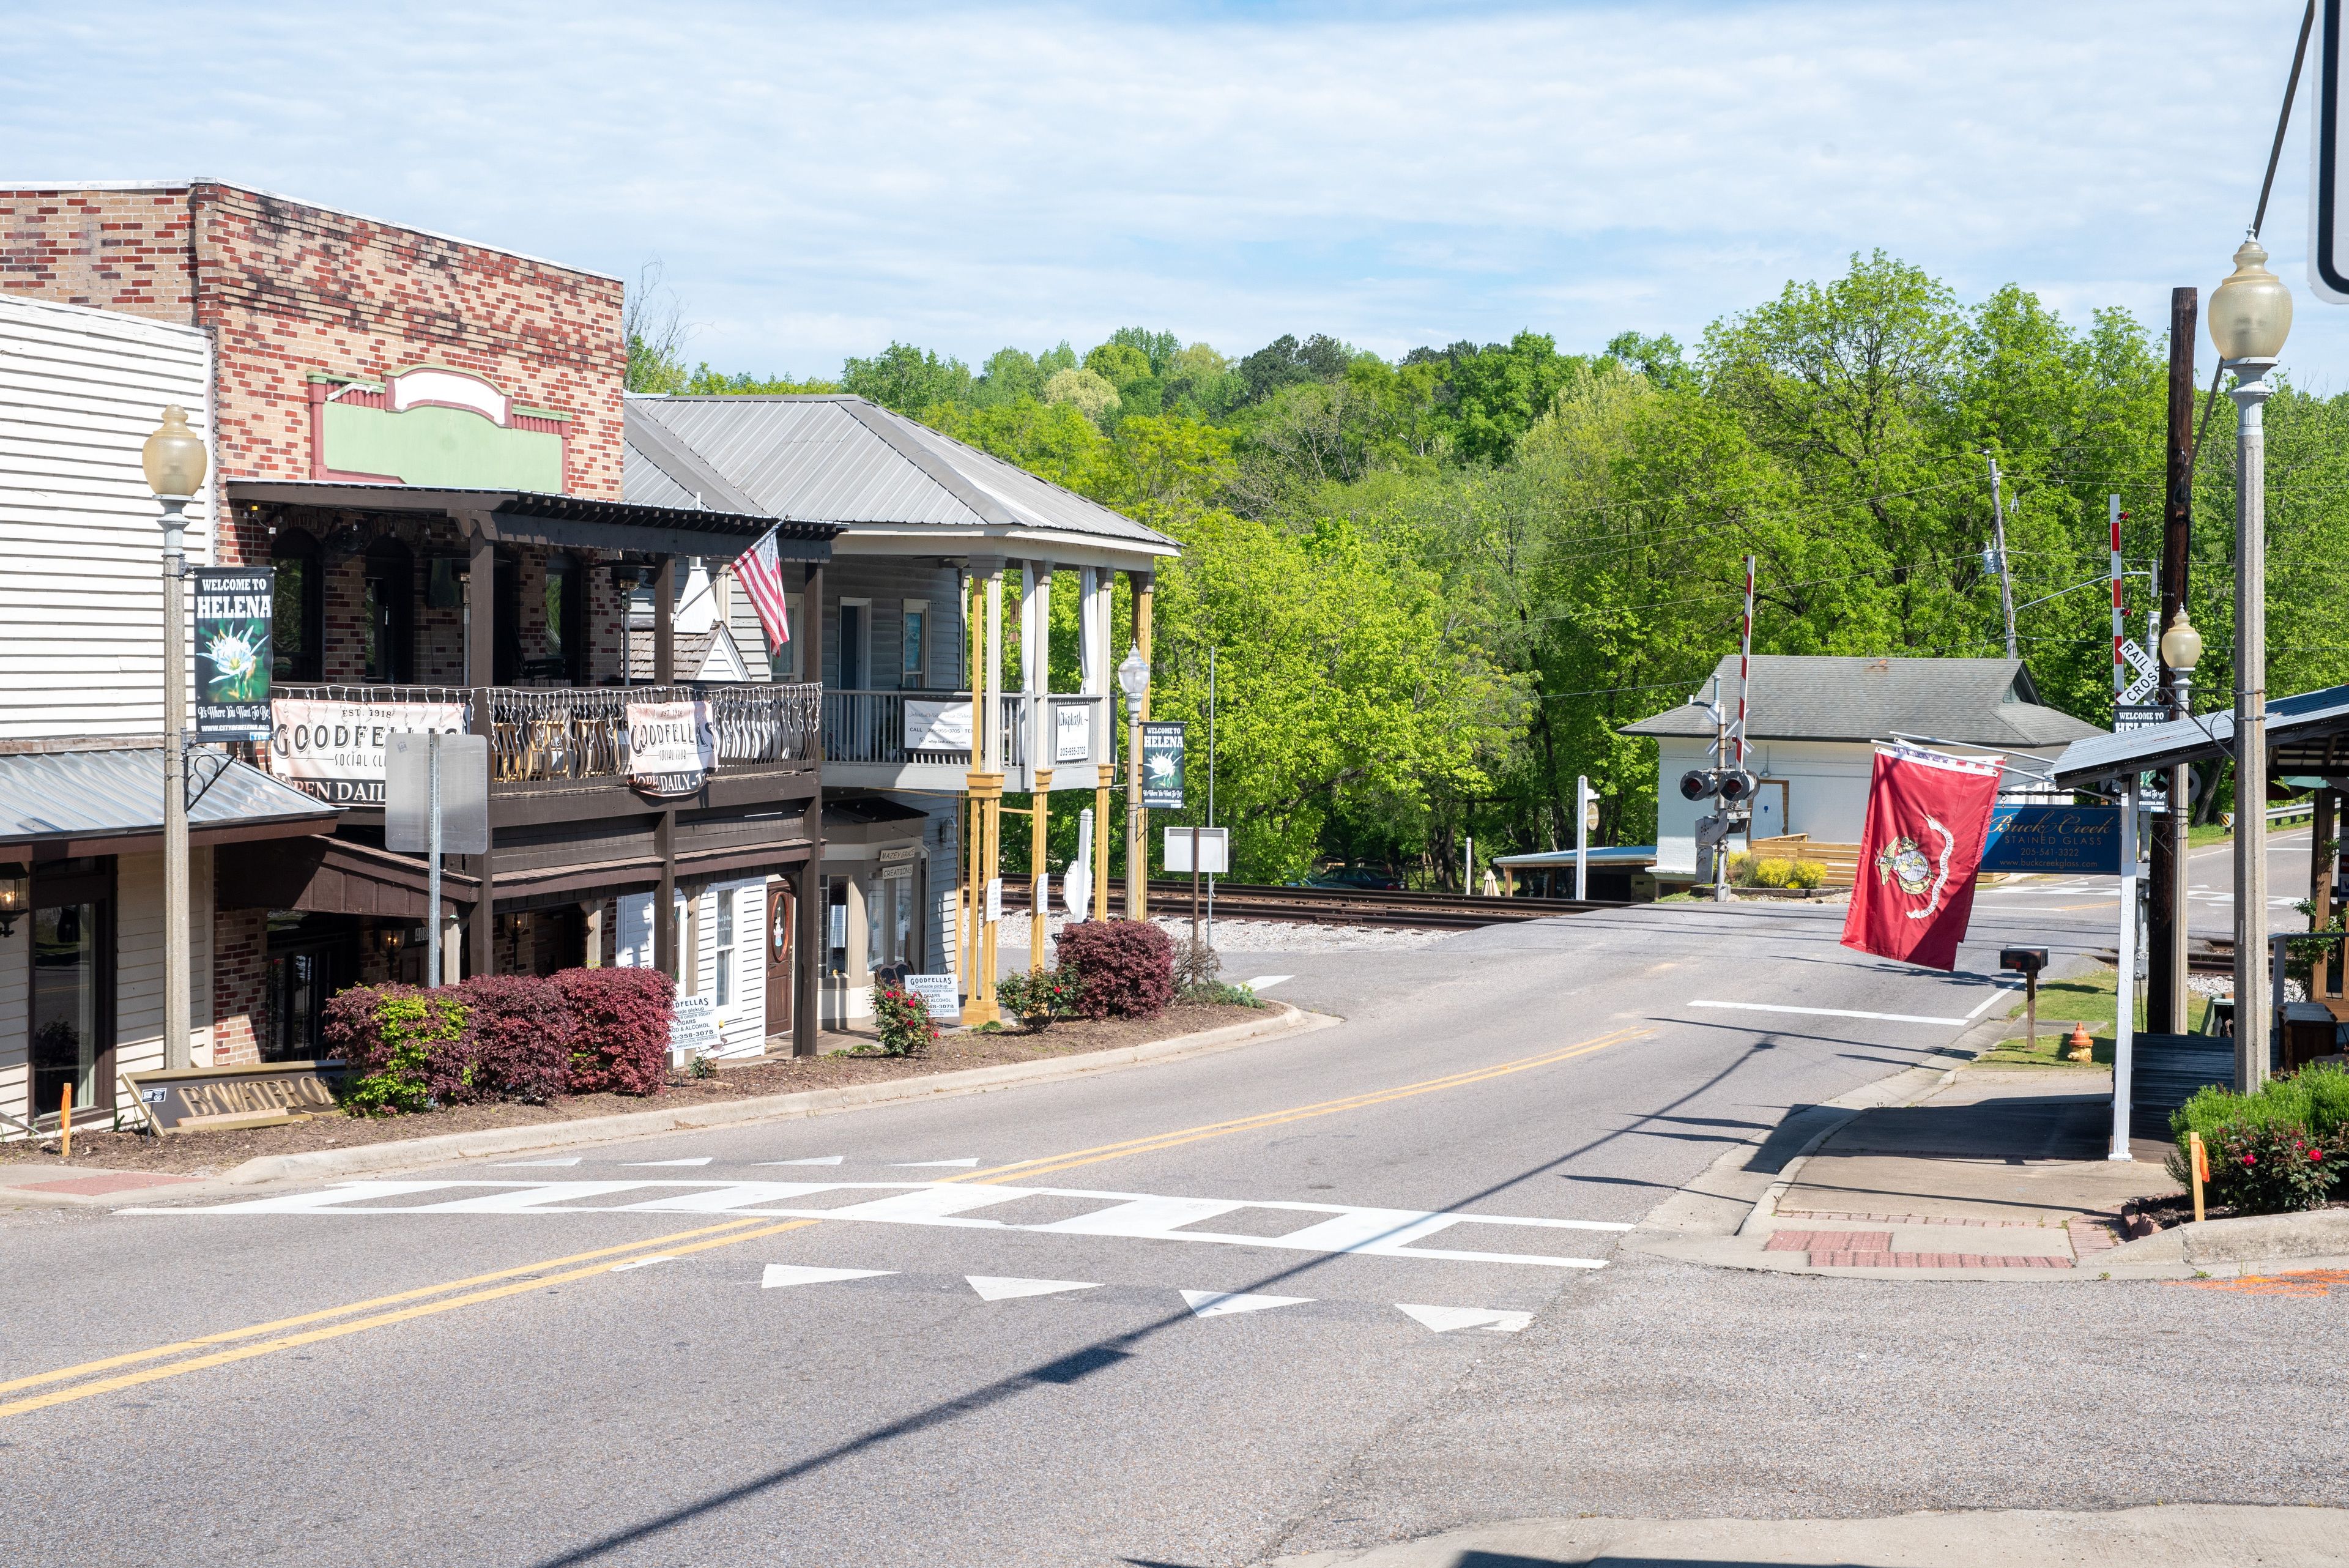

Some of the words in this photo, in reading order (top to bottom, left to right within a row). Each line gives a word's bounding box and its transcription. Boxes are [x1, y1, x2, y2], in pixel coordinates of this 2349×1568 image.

[202, 578, 251, 591] WELCOME
[252, 578, 267, 590] TO
[197, 595, 272, 619] HELENA
[2123, 643, 2148, 671] RAIL
[198, 706, 207, 719] It's
[207, 705, 225, 719] Where
[226, 705, 236, 718] You
[236, 705, 251, 719] Want
[251, 705, 259, 721] To
[260, 705, 270, 721] Be!
[369, 709, 392, 718] 1918
[1144, 736, 1183, 748] HELENA
[335, 754, 367, 767] SOCIAL
[659, 749, 674, 761] SOCIAL
[676, 749, 686, 760] CLUB
[292, 781, 331, 800] PEN
[337, 782, 386, 802] DAIL
[1988, 810, 2057, 839] Buck
[2057, 814, 2115, 834] Creek
[2005, 836, 2056, 845] STAINED
[2063, 837, 2102, 845] GLASS
[2021, 847, 2080, 857] 205-541-3322
[2000, 858, 2098, 869] www.buckcreekglass.com
[884, 867, 912, 877] CREATIONS
[675, 998, 709, 1008] DFELLAS
[685, 1022, 710, 1031] ALCOHOL
[673, 1030, 714, 1041] 5-358-3078
[176, 1079, 307, 1117] BYWATER
